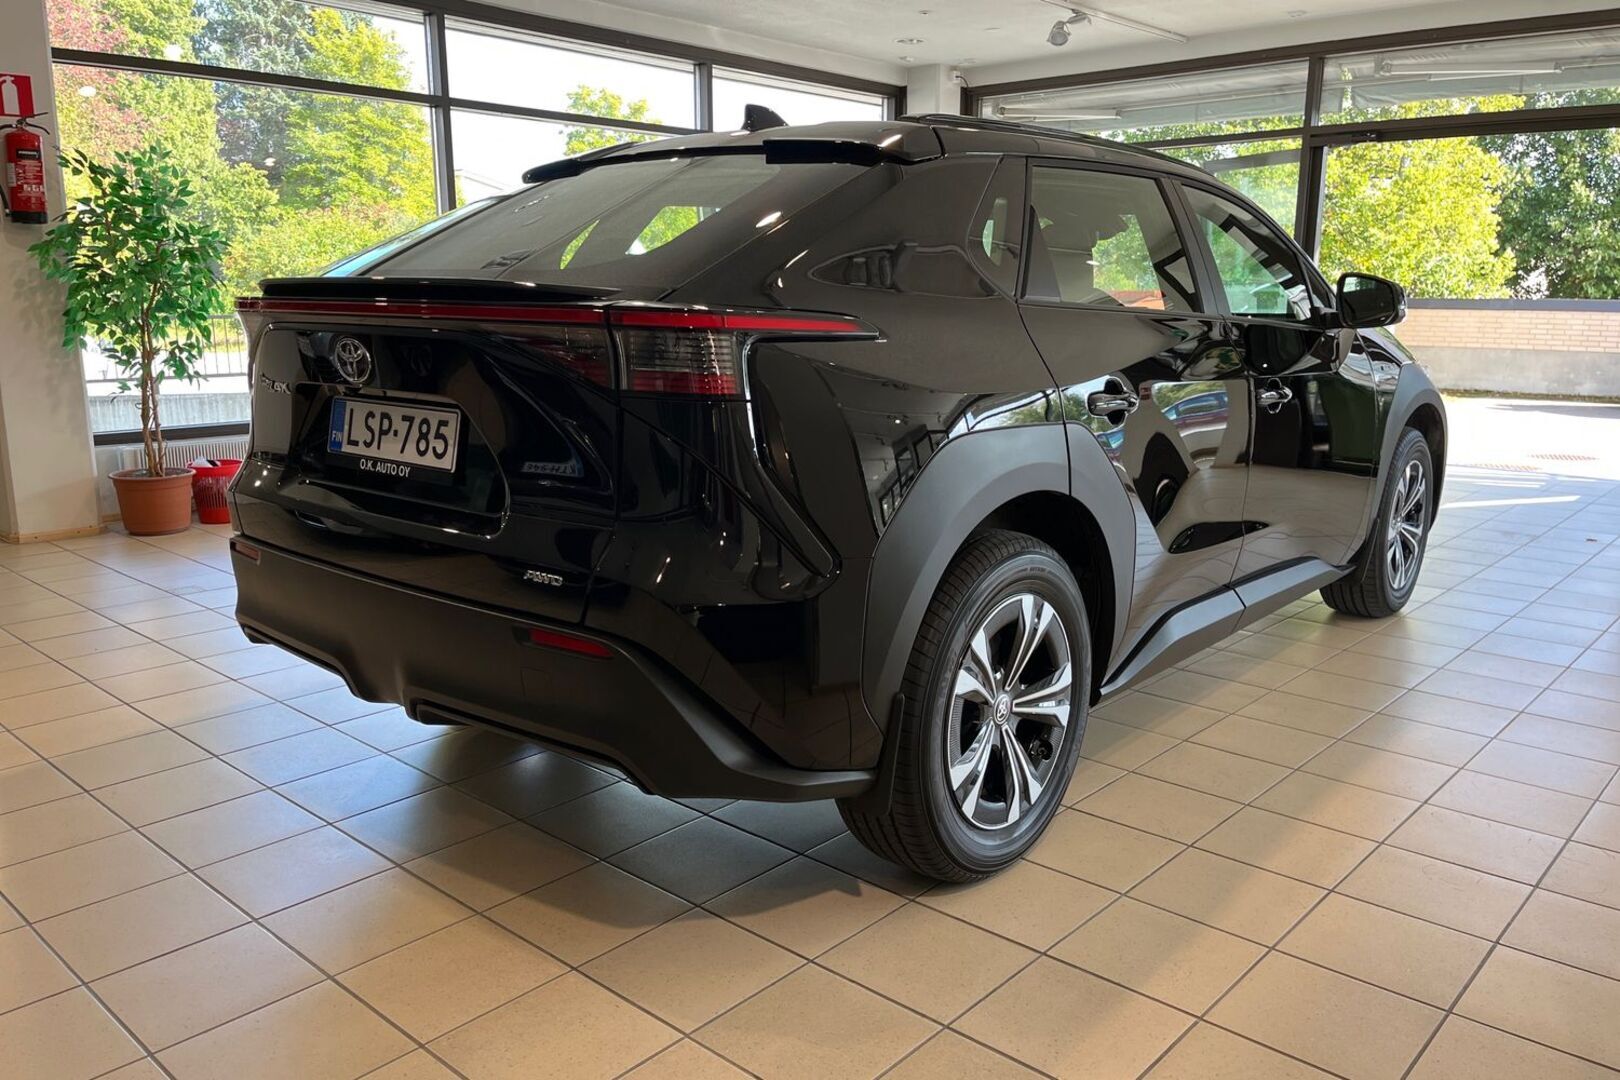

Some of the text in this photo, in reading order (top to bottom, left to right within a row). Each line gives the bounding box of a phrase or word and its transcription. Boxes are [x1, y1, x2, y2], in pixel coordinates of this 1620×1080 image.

[331, 430, 342, 442] FIN
[347, 408, 449, 460] LSP-785
[360, 459, 411, 478] O.K. AUTO OY
